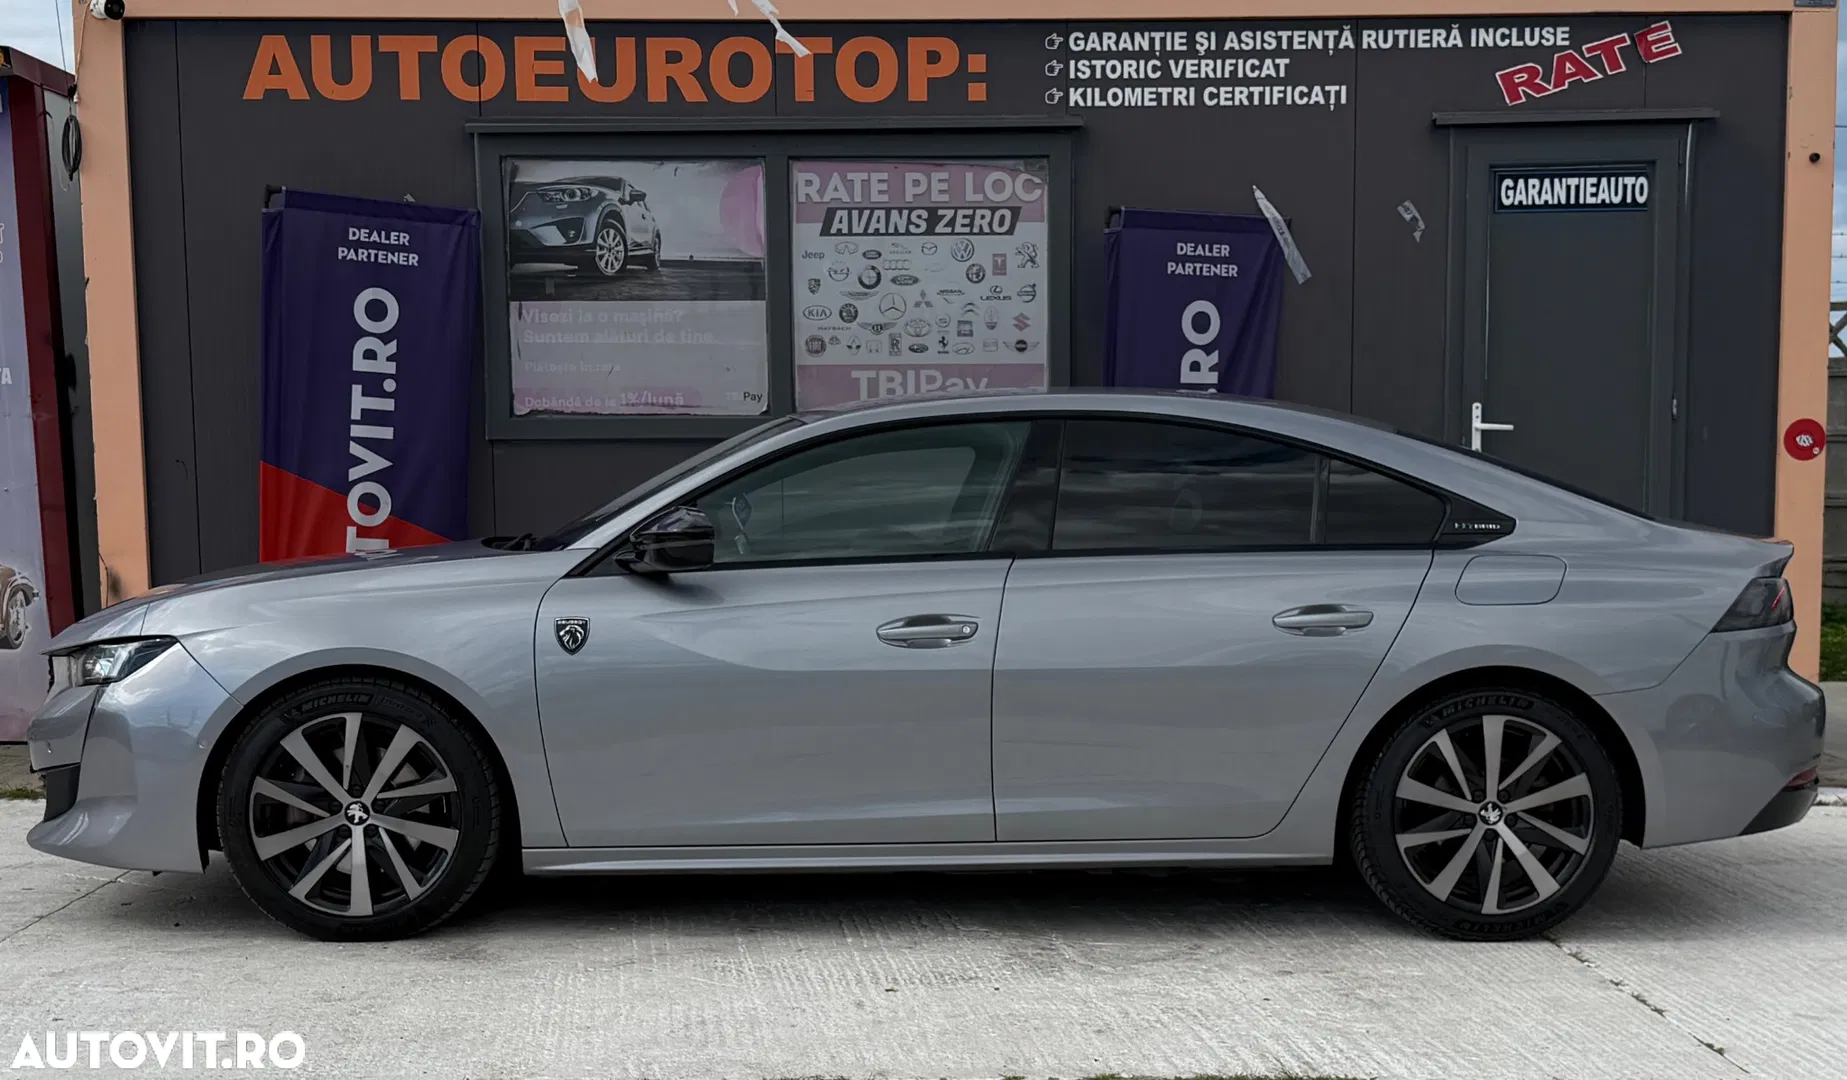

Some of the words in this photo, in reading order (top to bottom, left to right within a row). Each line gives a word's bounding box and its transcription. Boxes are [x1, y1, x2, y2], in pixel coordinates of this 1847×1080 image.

[1068, 31, 1188, 56] GARANȚIE
[1223, 25, 1353, 55] ASISTENȚĂ
[1362, 24, 1463, 49] RUTIERĂ
[1471, 27, 1570, 47] INCLUSE
[242, 35, 987, 103] AUTOEUROTOP:
[1069, 59, 1161, 79] ISTORIC
[1169, 58, 1290, 79] VERIFICAT
[1495, 20, 1682, 107] RATE
[1069, 87, 1195, 107] KILOMETRI
[1203, 85, 1347, 111] CERTIFICAȚI
[798, 171, 889, 203] RATE
[905, 171, 949, 202] PE
[965, 171, 1043, 202] LOC
[1500, 176, 1649, 206] GARANTIEAUTO
[830, 209, 928, 234] AVANS
[934, 208, 1012, 234] ZERO
[348, 227, 410, 246] DEALER
[338, 246, 419, 266] PARTENER
[802, 249, 825, 260] Jeep
[1176, 242, 1230, 257] DEALER
[1167, 262, 1238, 277] PARTENER
[807, 309, 828, 317] KIA
[301, 693, 373, 712] MICHELIN
